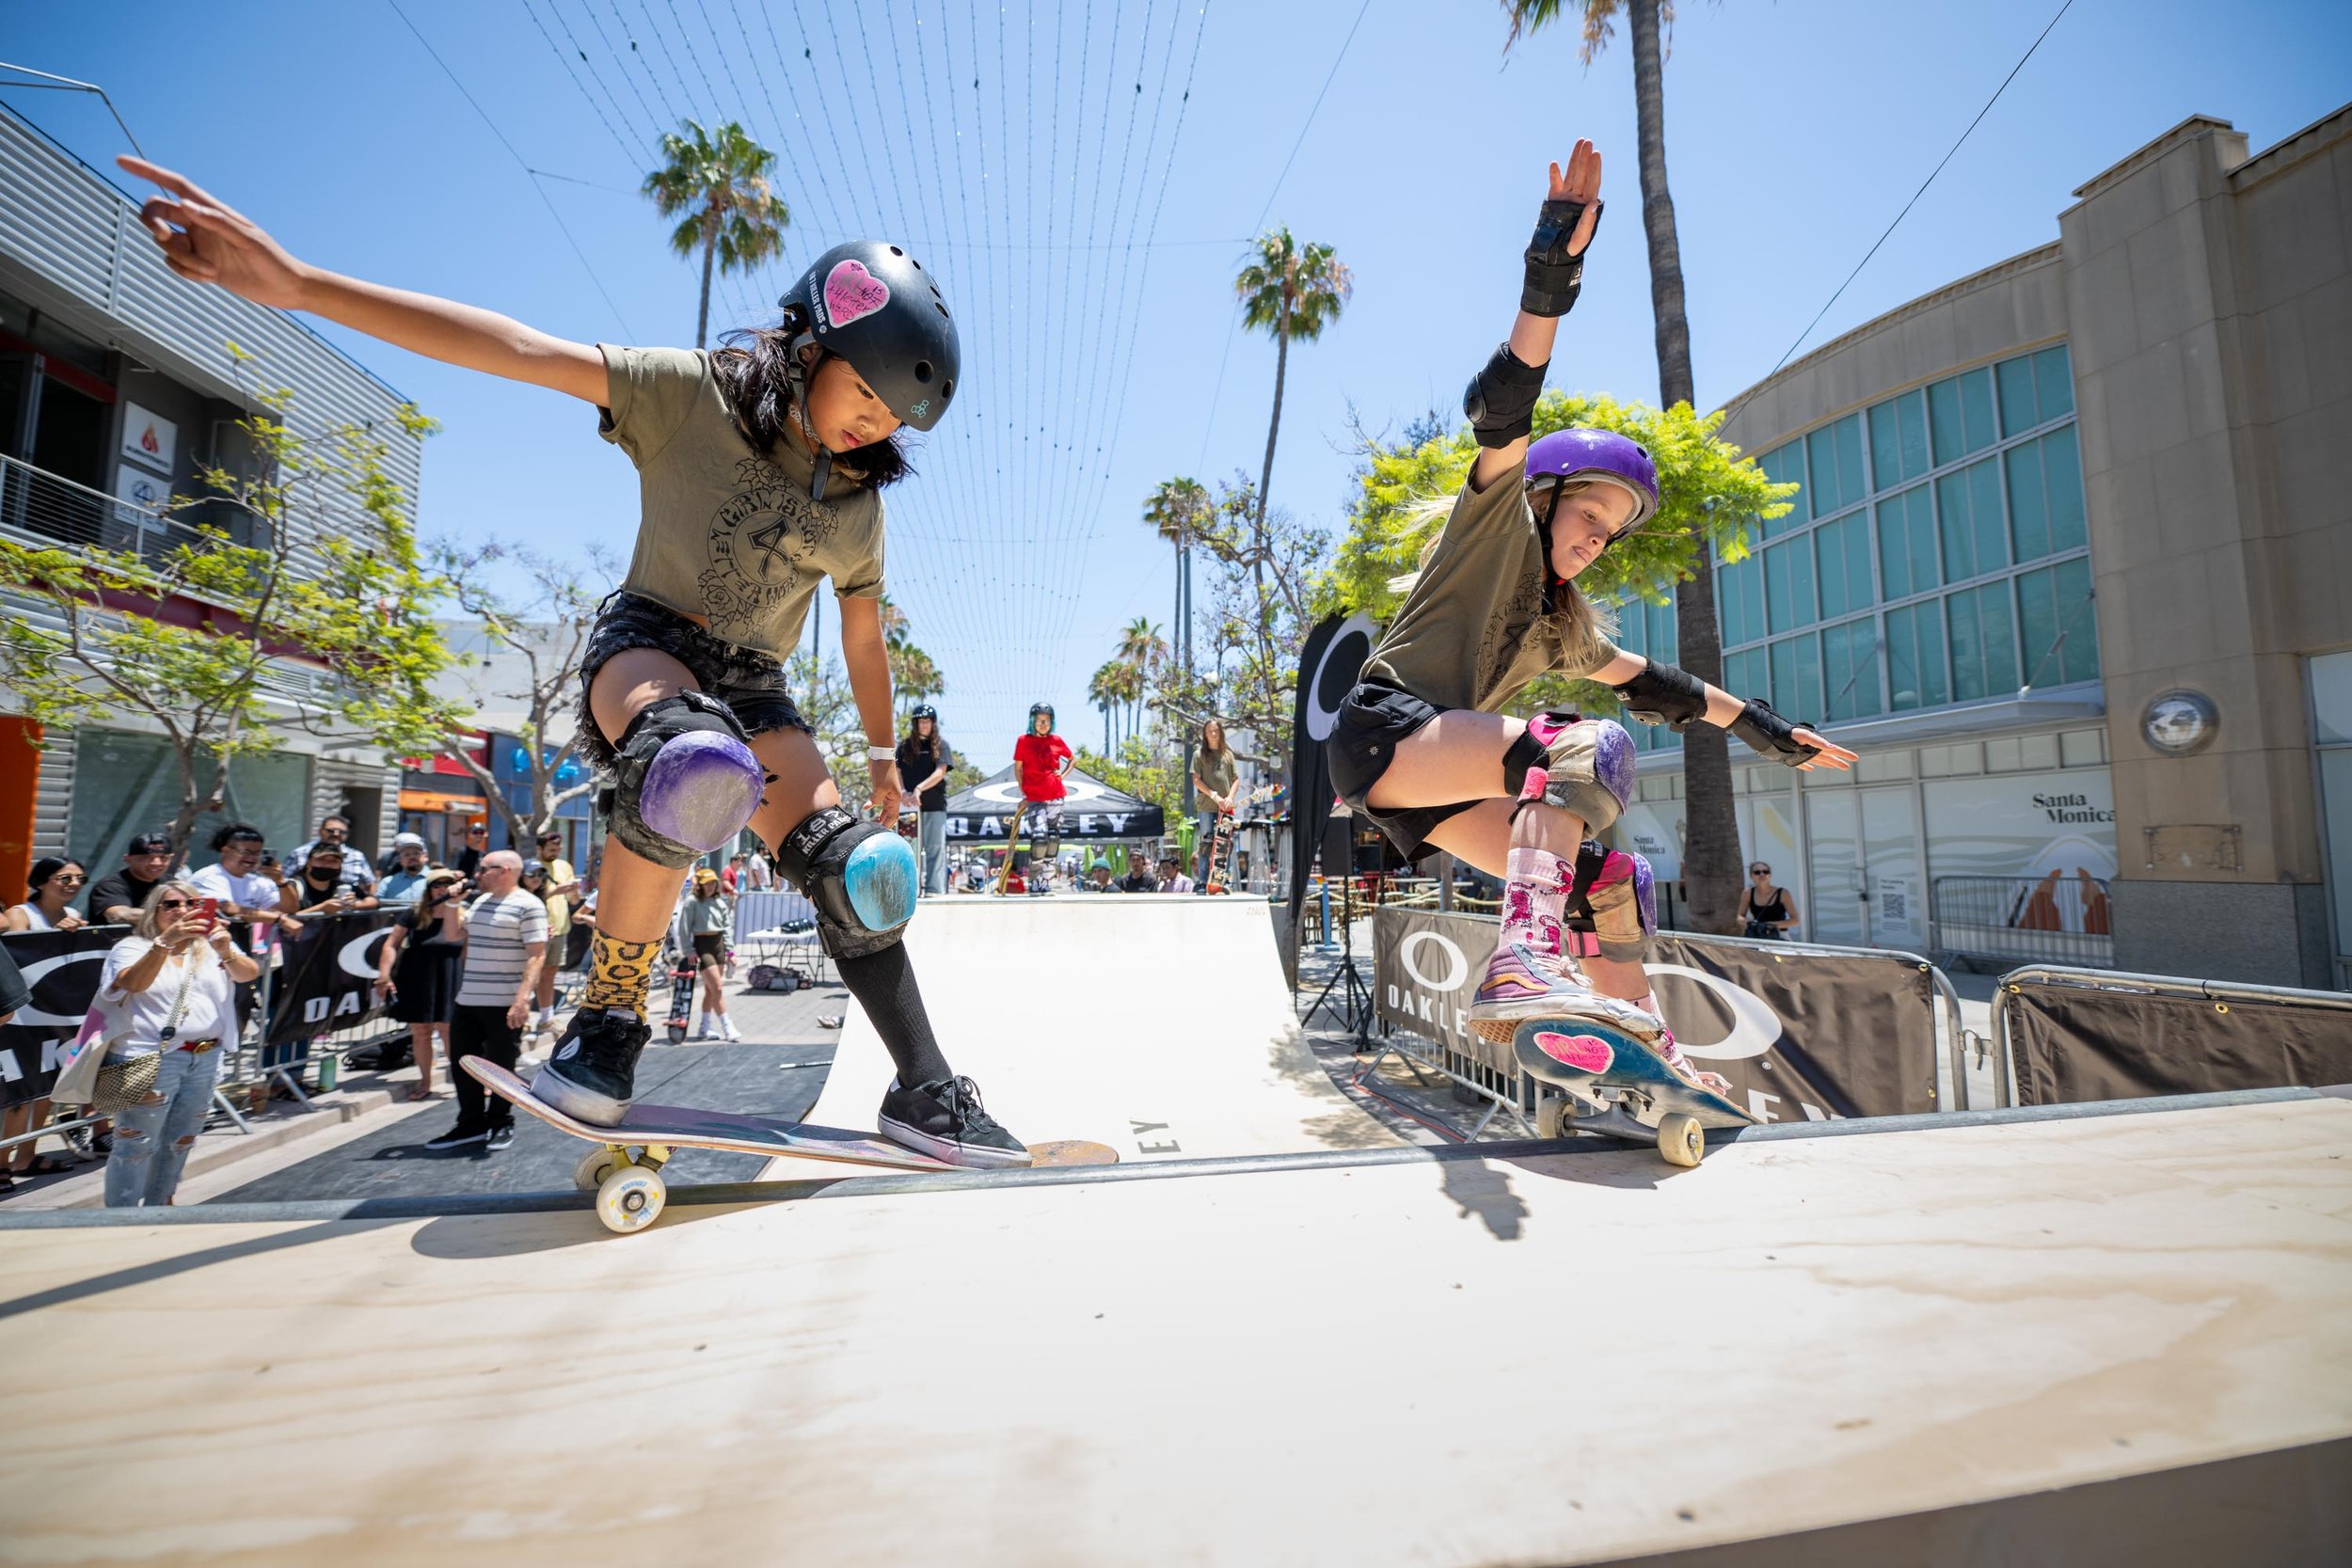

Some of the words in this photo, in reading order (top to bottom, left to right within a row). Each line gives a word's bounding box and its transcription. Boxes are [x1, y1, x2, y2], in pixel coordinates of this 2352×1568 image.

[810, 282, 820, 304] KILLER
[814, 303, 826, 324] PADS
[2032, 793, 2088, 809] Santa
[796, 810, 840, 847] 187
[802, 828, 830, 855] KILLER
[828, 815, 852, 830] PADS
[946, 813, 1133, 837] OAKEY
[1633, 834, 1655, 845] Santa
[1639, 845, 1666, 855] Monica
[1388, 983, 1486, 1046] OAKLE
